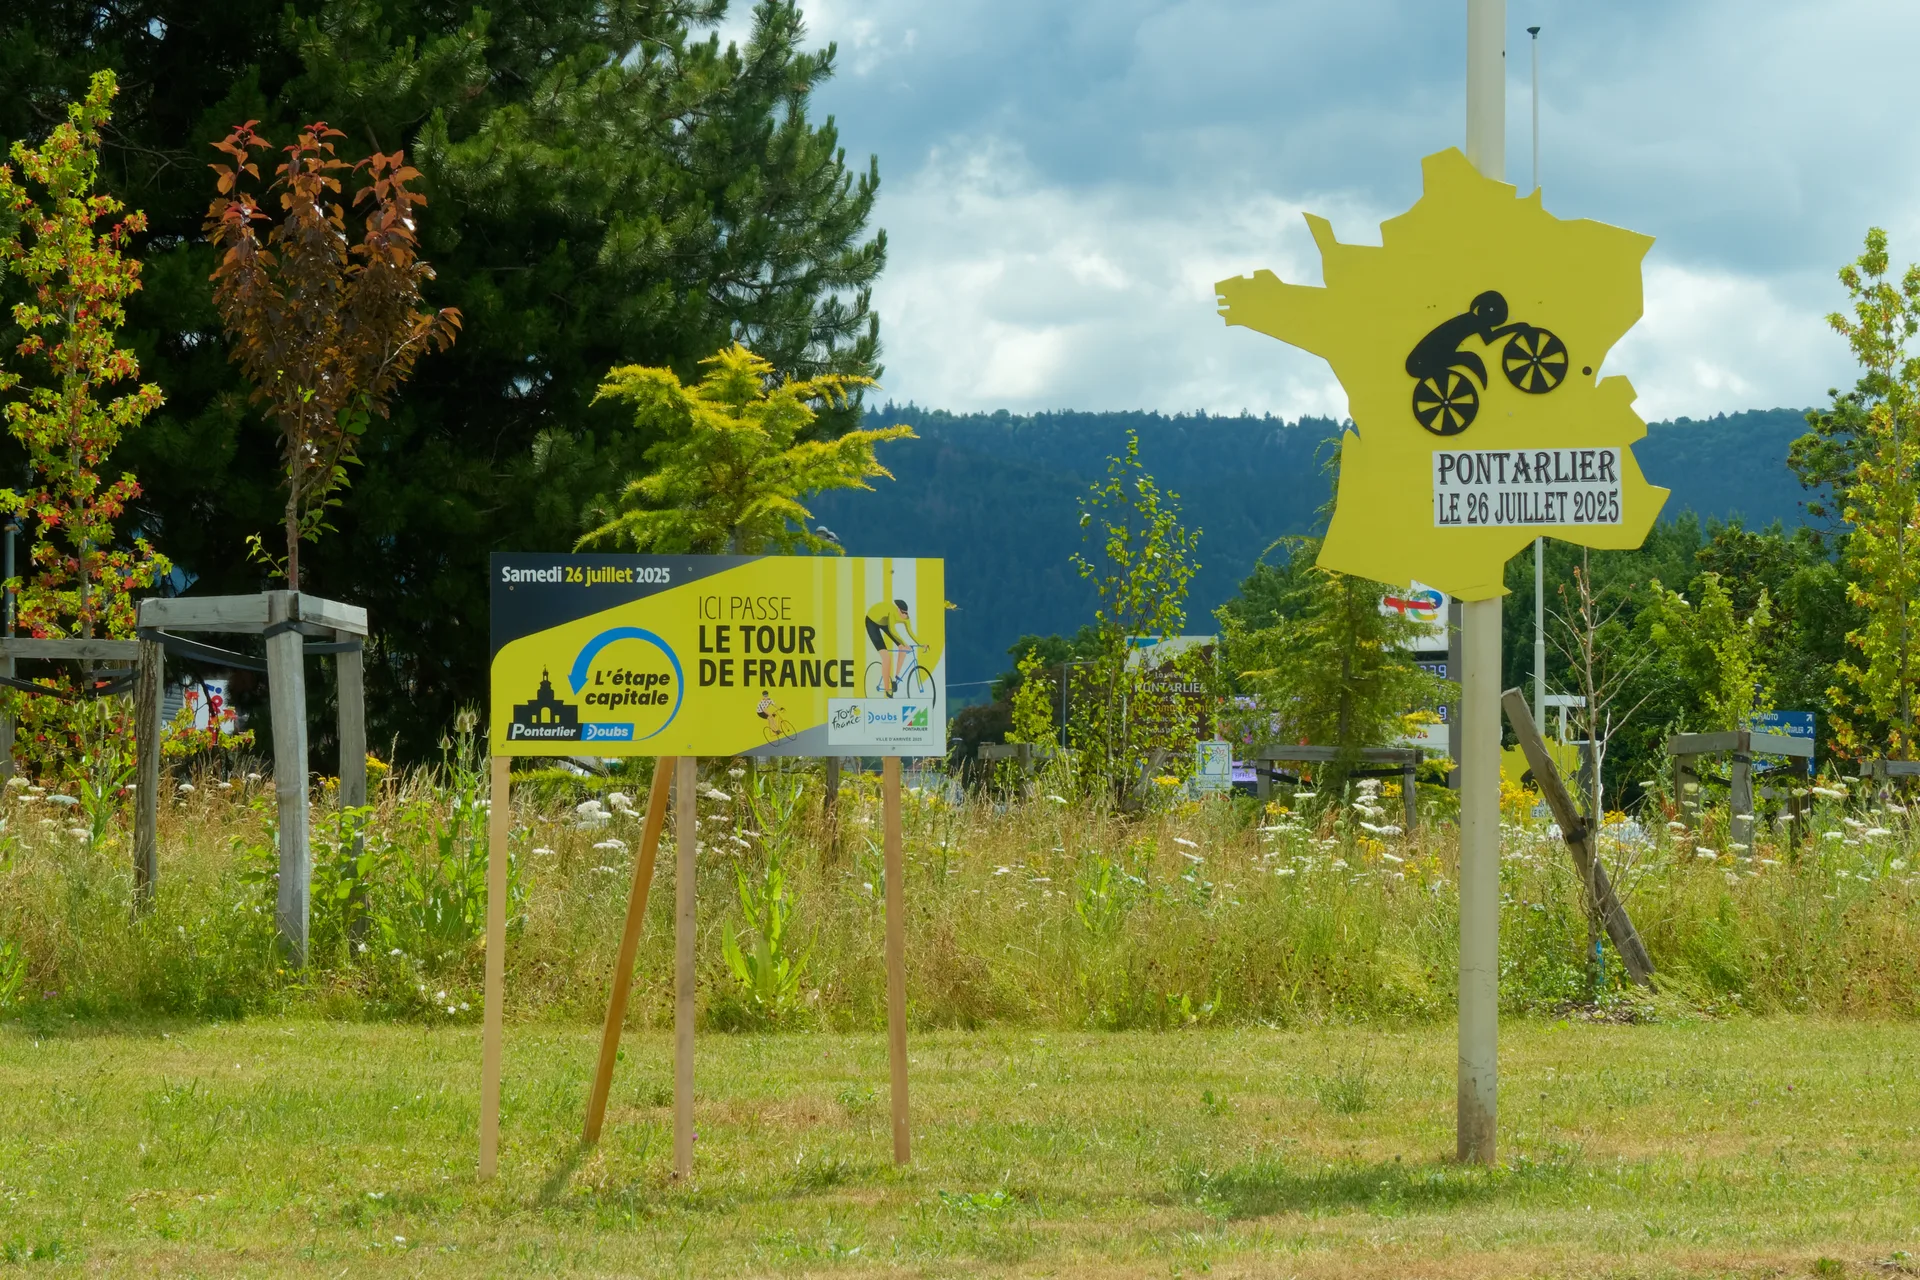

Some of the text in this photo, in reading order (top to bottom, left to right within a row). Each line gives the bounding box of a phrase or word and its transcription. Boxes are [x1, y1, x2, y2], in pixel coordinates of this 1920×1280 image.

[1438, 450, 1618, 486] PONTARLIER
[1439, 488, 1620, 525] LE 26 JUILLET 2025
[501, 566, 671, 588] Samedi 26 juillet 2025
[698, 596, 792, 621] ICI PASSE
[699, 624, 816, 654] LE TOUR
[699, 658, 855, 688] DE FRANCE
[584, 688, 669, 711] capitale
[511, 723, 630, 740] Pontarlier Doubs
